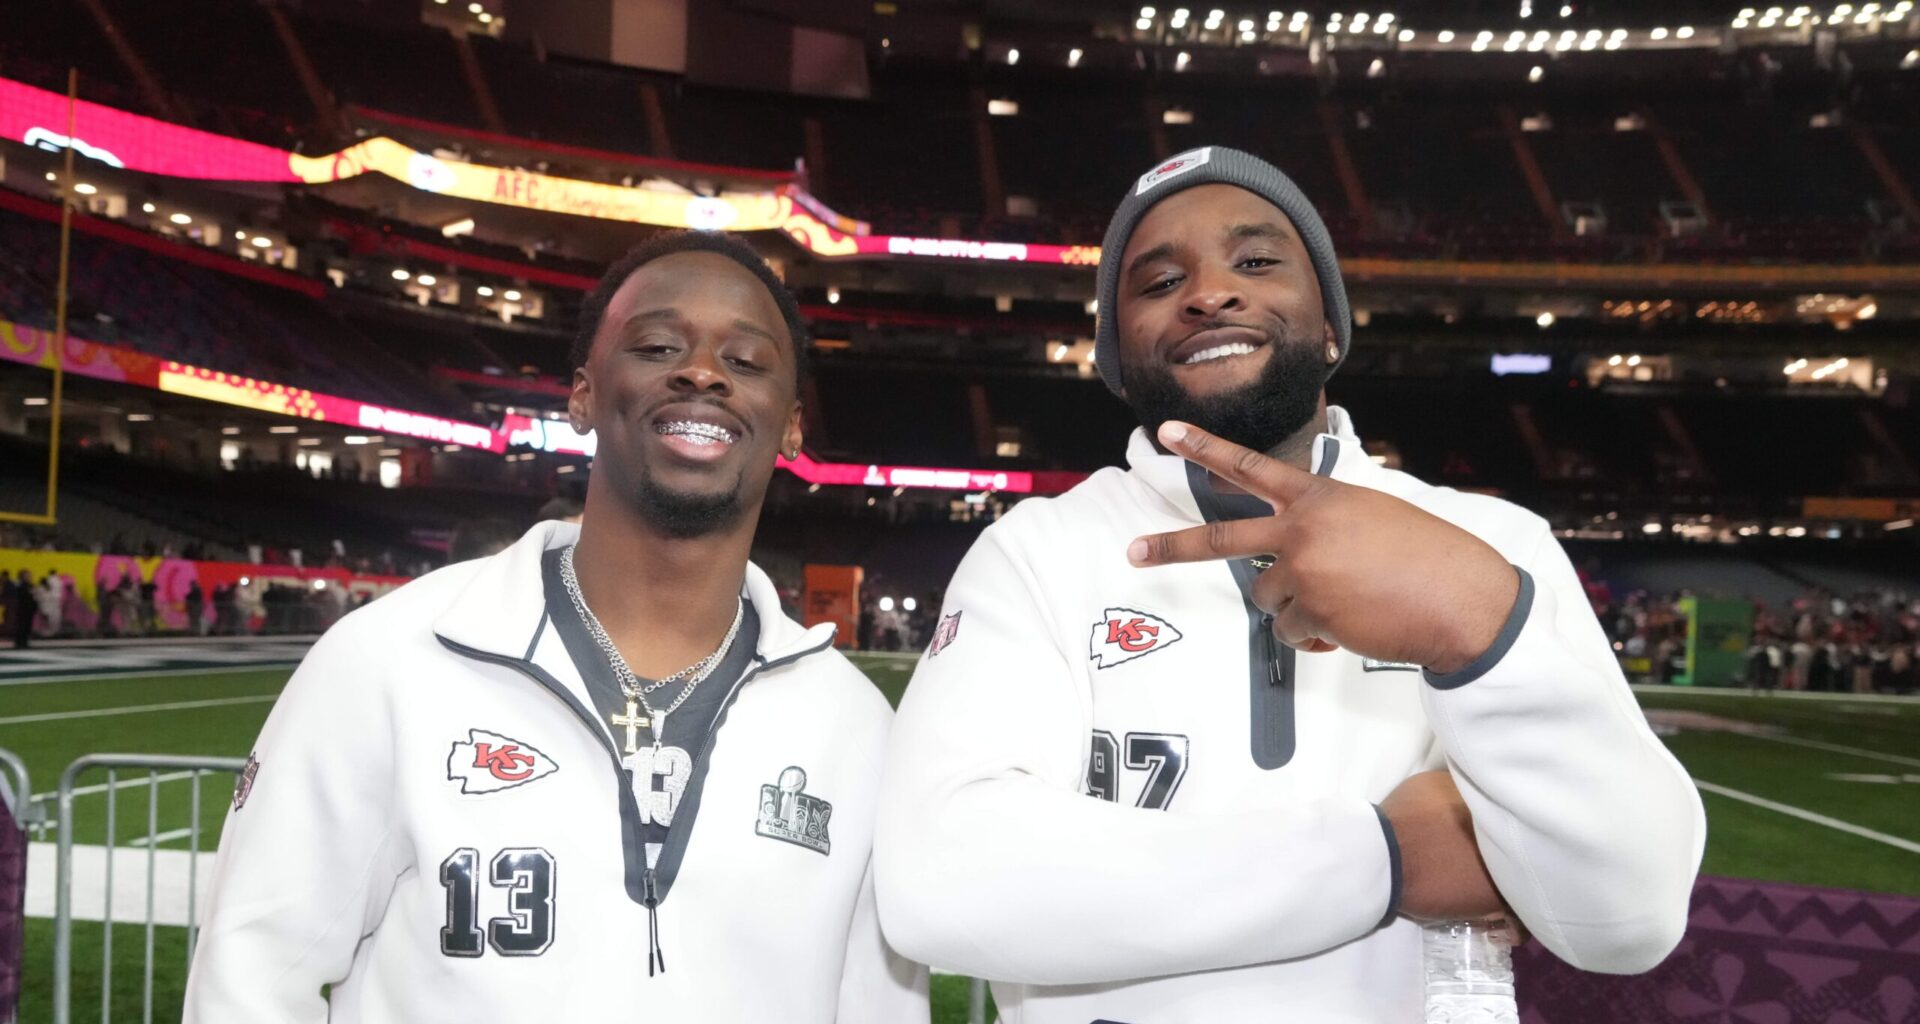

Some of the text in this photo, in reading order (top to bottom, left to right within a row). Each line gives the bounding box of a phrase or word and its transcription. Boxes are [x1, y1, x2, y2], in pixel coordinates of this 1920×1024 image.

[495, 174, 539, 204] AFC
[1105, 617, 1160, 652] KC
[471, 742, 535, 782] KC
[623, 746, 693, 827] 13
[1086, 729, 1189, 811] 97
[439, 847, 557, 959] 13
